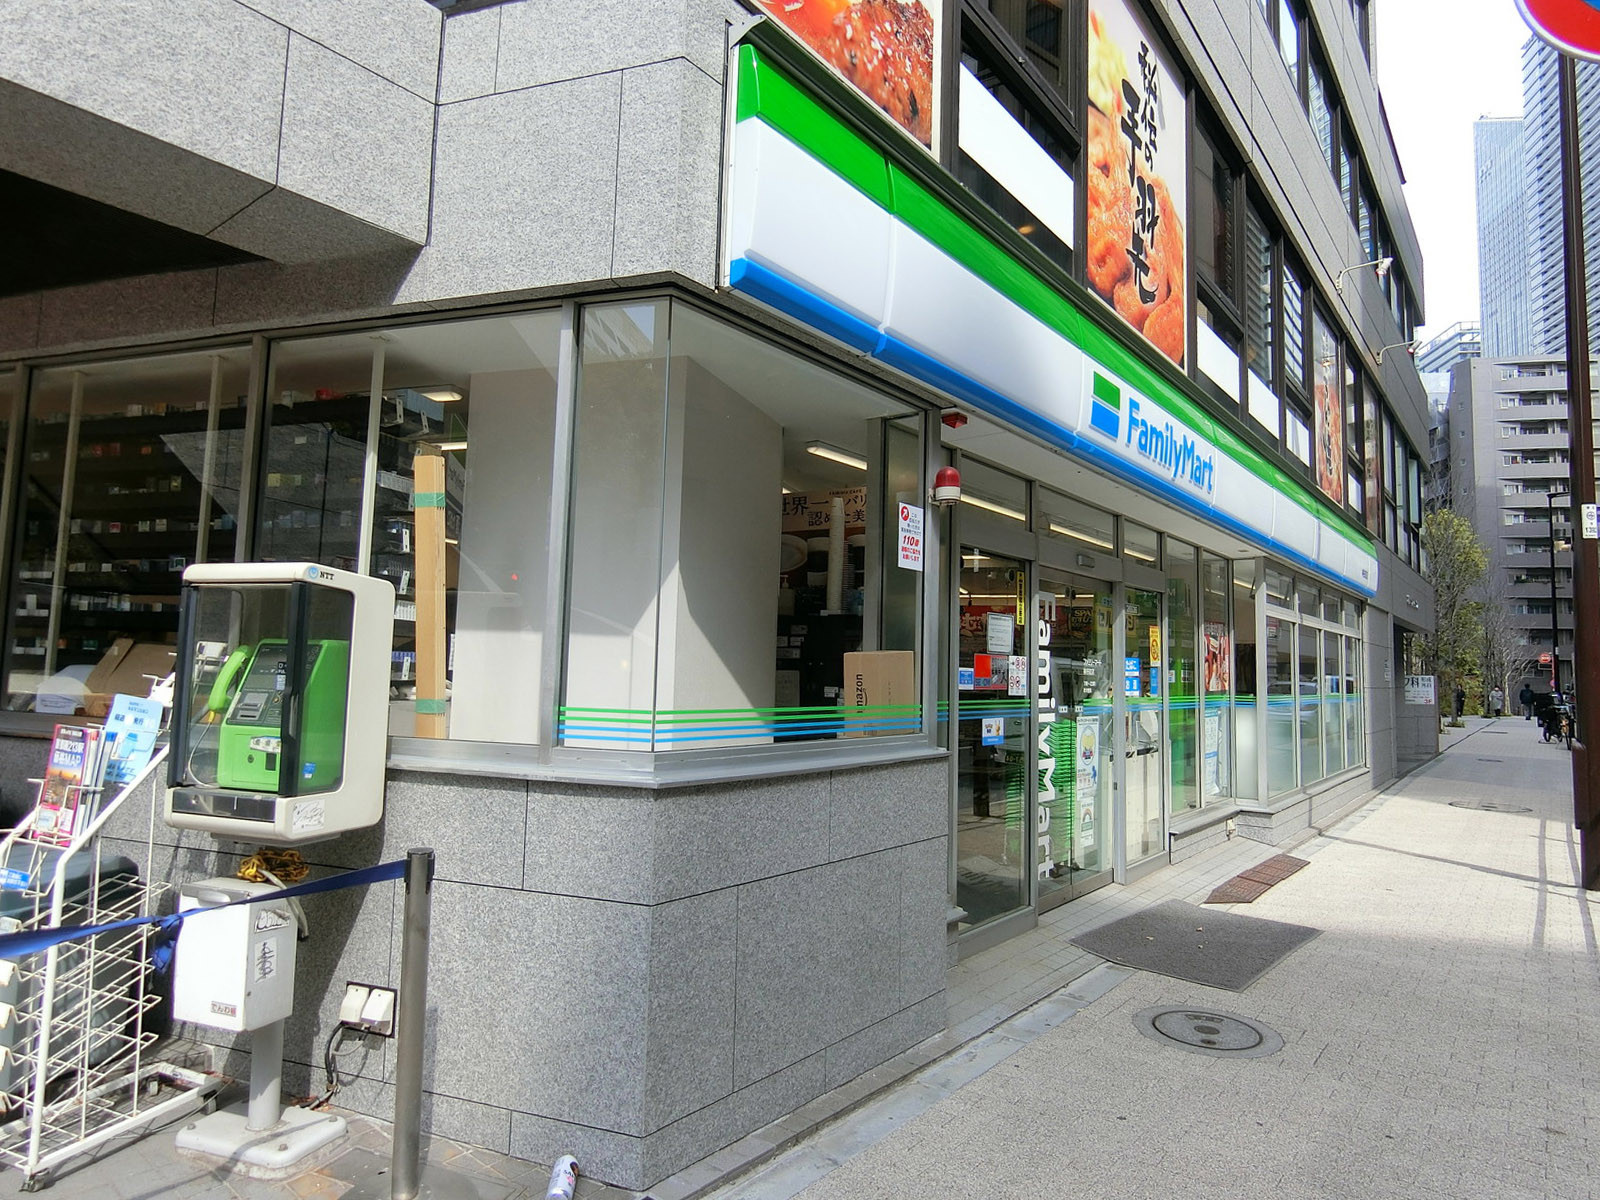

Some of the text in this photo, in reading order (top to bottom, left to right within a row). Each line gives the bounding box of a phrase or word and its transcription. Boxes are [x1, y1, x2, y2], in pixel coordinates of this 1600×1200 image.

[1121, 78, 1160, 305] 手羽先
[1126, 397, 1213, 492] FamilyMart
[320, 571, 335, 580] NTT
[1038, 592, 1057, 881] FamilyMart
